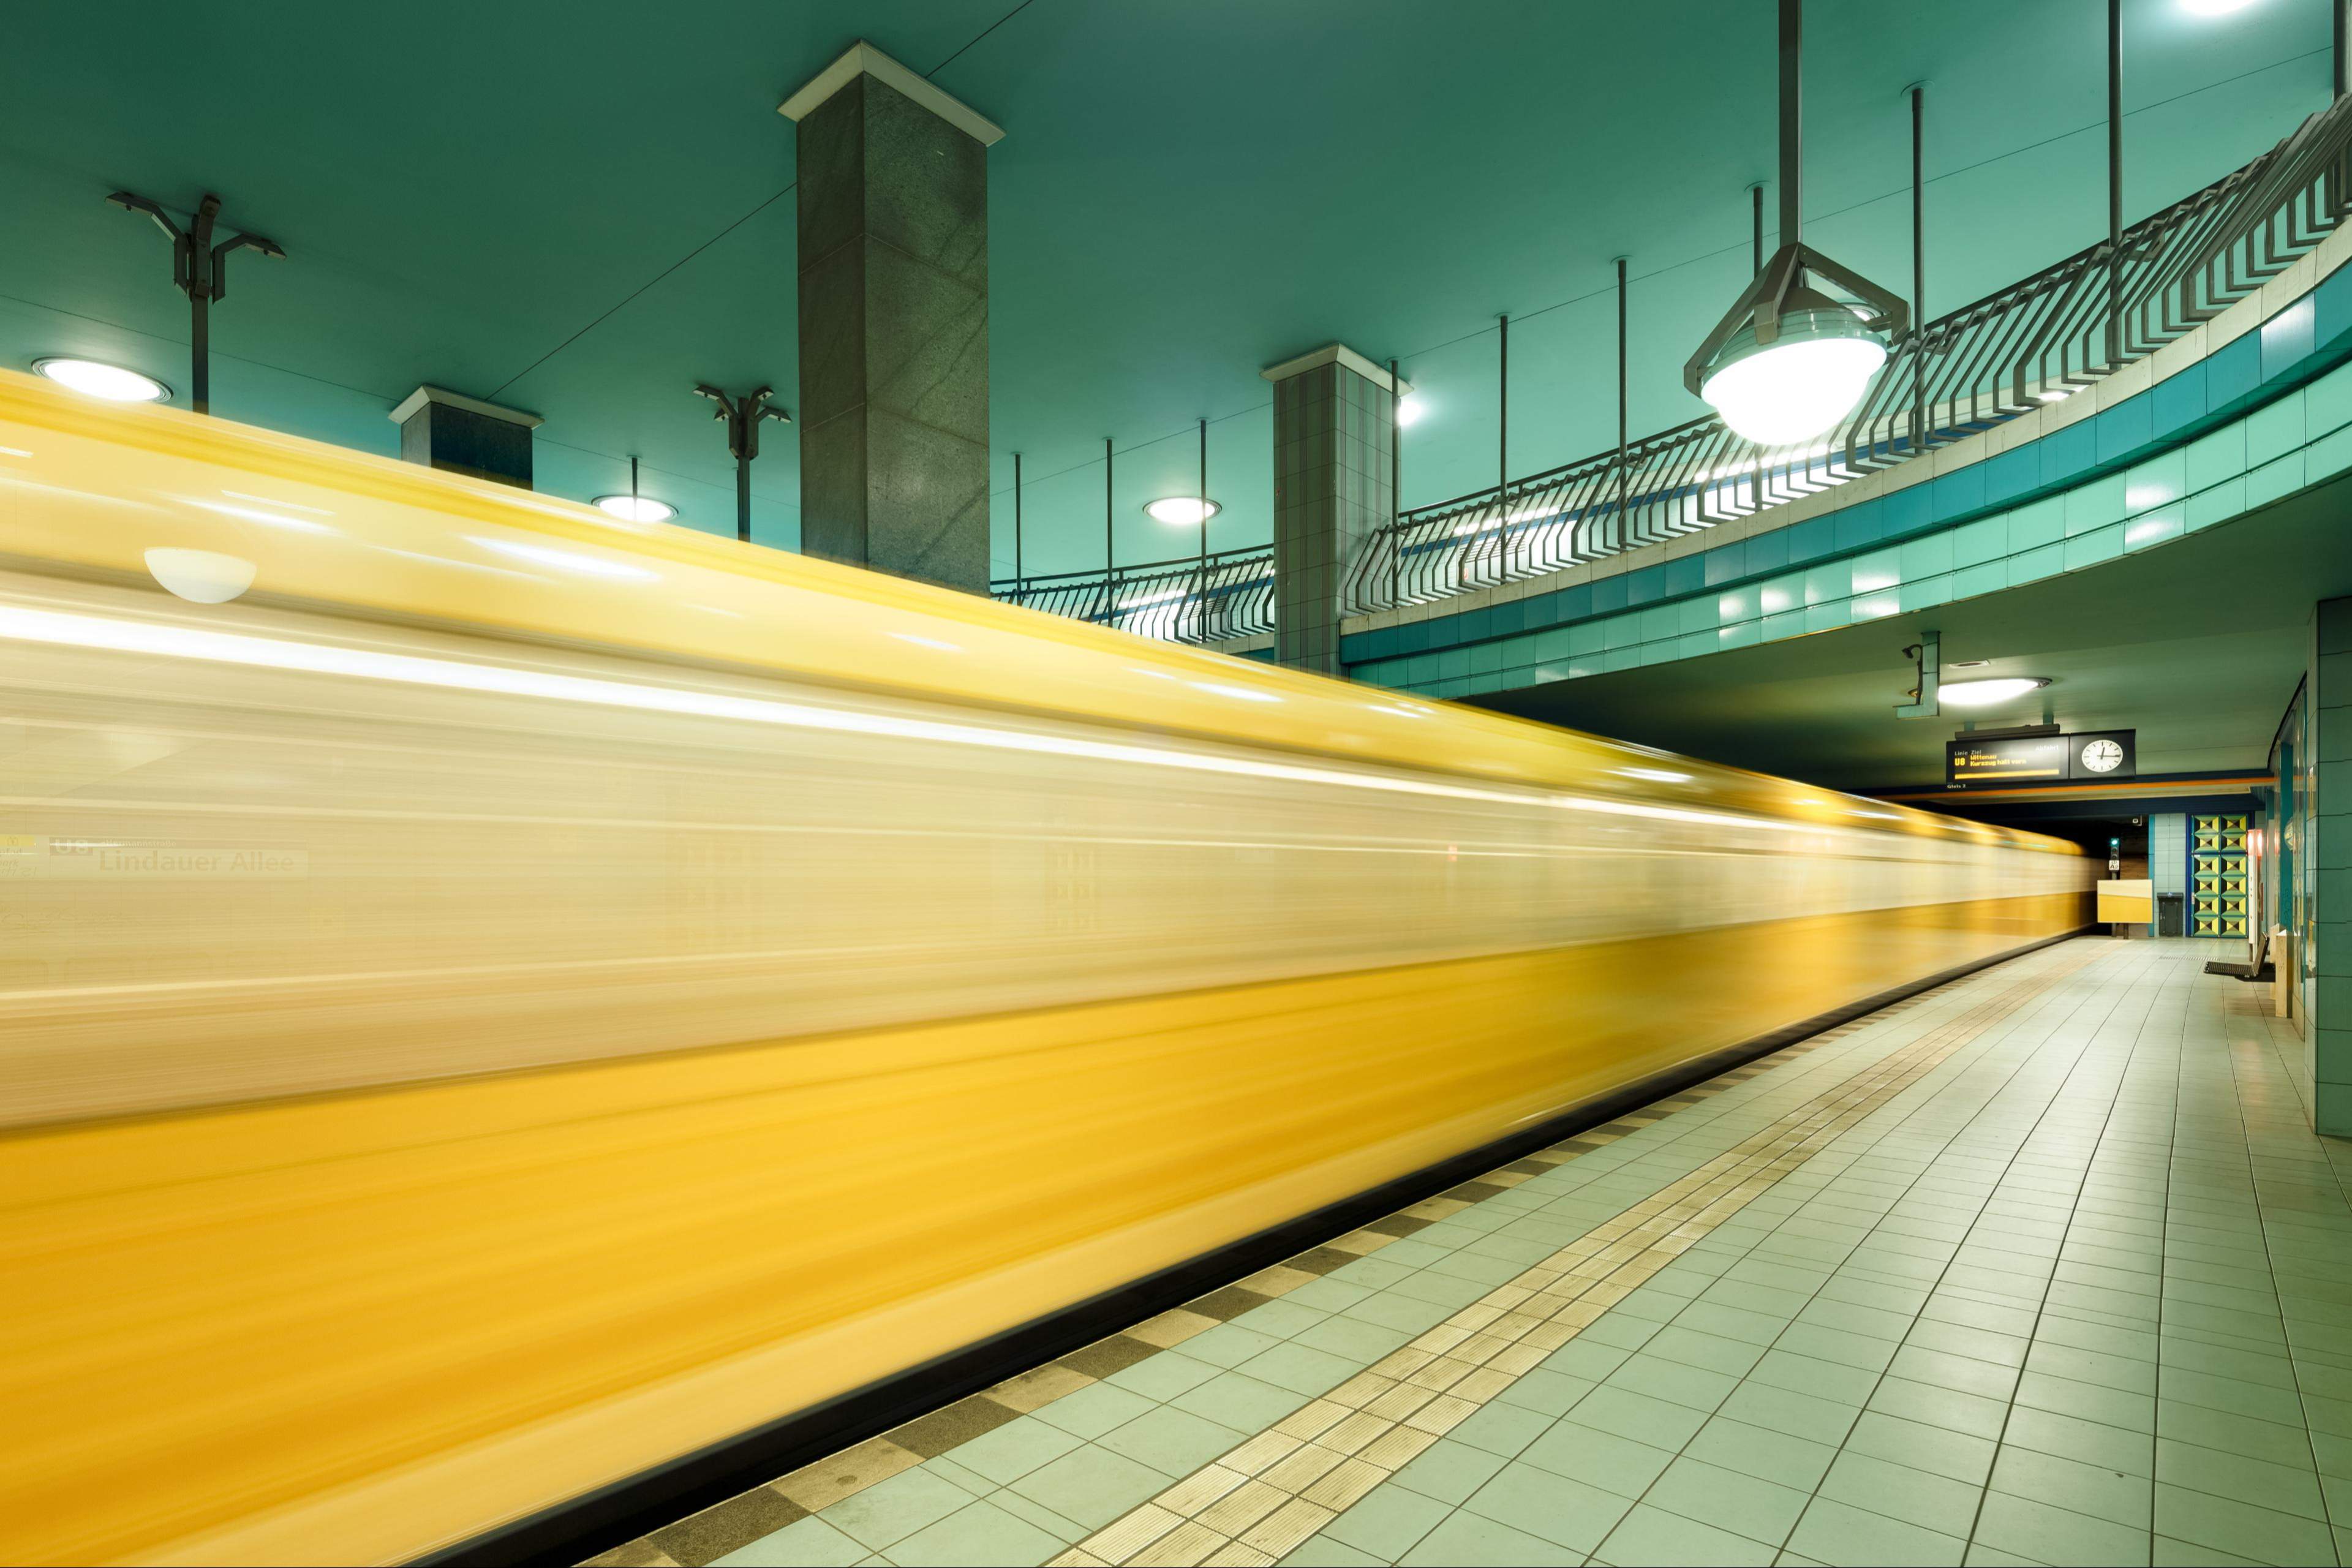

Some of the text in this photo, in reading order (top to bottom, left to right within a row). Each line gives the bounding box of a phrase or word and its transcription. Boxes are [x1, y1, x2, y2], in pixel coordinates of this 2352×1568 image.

[1954, 757, 1966, 766] U8
[55, 839, 89, 854] U8
[99, 850, 295, 872] Lindauer Allee
